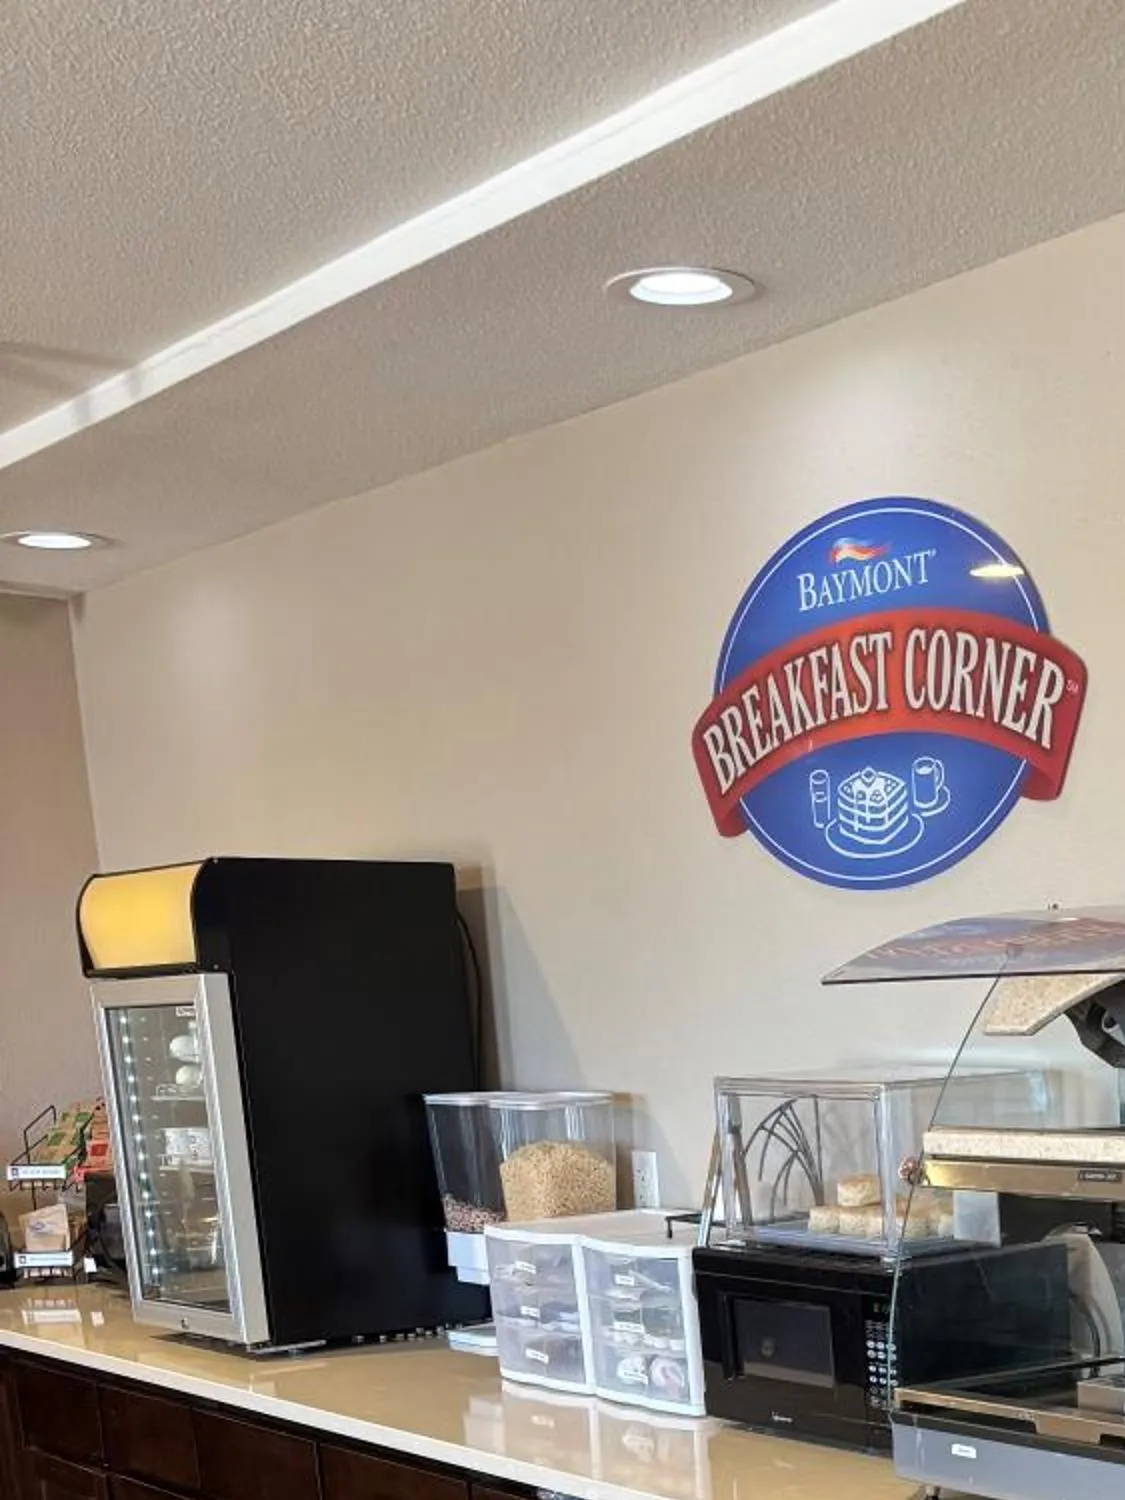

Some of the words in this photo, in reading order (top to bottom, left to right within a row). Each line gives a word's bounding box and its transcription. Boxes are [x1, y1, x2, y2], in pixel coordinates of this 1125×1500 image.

[796, 549, 930, 612] BAYMONT
[702, 630, 893, 796] BREAKFAST
[904, 628, 1065, 750] CORNER
